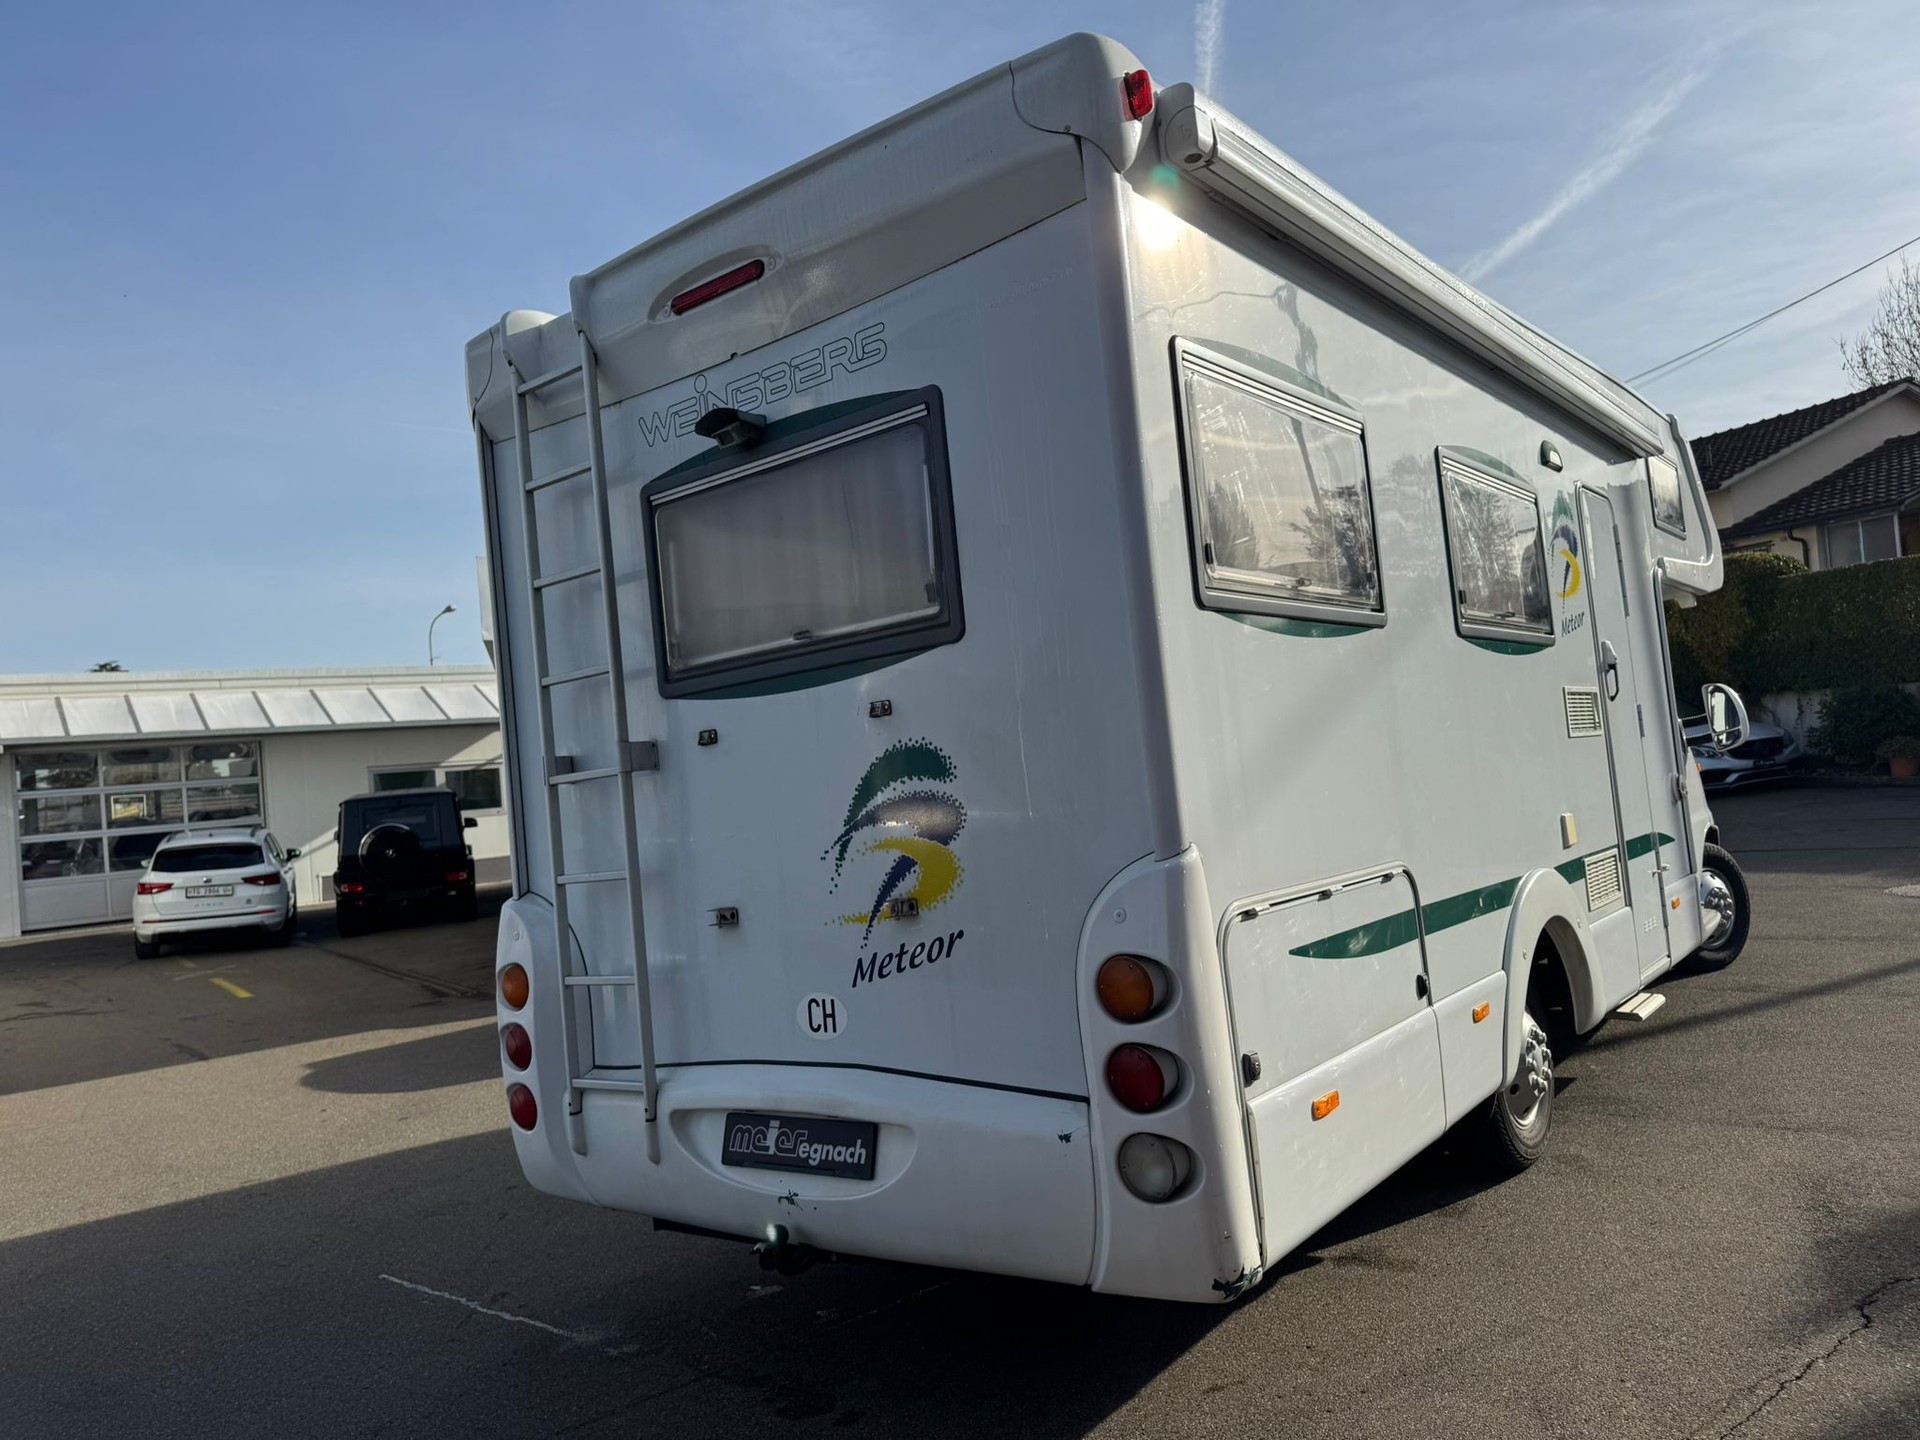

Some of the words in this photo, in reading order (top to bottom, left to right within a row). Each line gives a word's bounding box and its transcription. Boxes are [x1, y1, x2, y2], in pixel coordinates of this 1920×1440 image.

[1561, 611, 1585, 638] Meteor
[852, 929, 965, 988] Meteor
[807, 998, 837, 1034] CH
[799, 1138, 866, 1166] egnach
